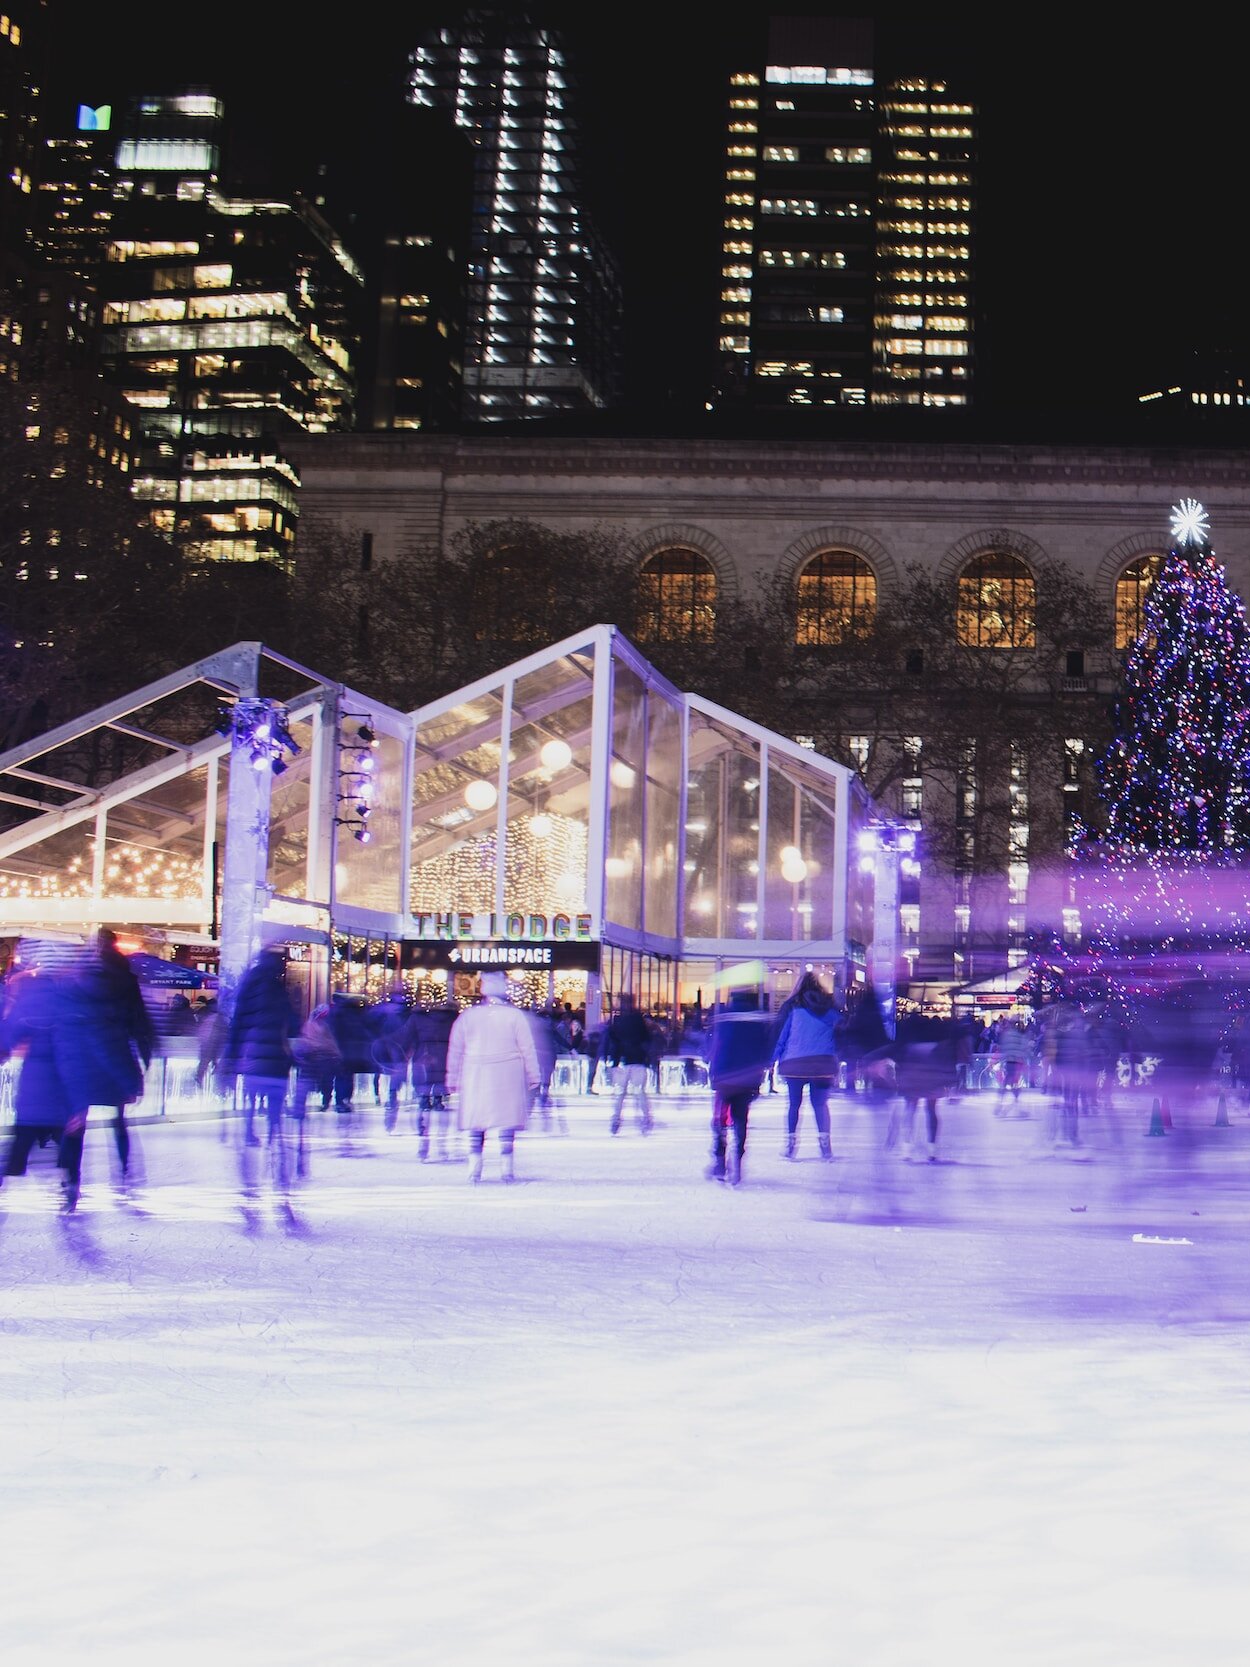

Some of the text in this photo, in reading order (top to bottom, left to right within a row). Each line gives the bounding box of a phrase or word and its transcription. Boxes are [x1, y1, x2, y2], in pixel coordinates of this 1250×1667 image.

[412, 912, 592, 942] THE LODGE
[462, 947, 552, 964] URBANSPACE
